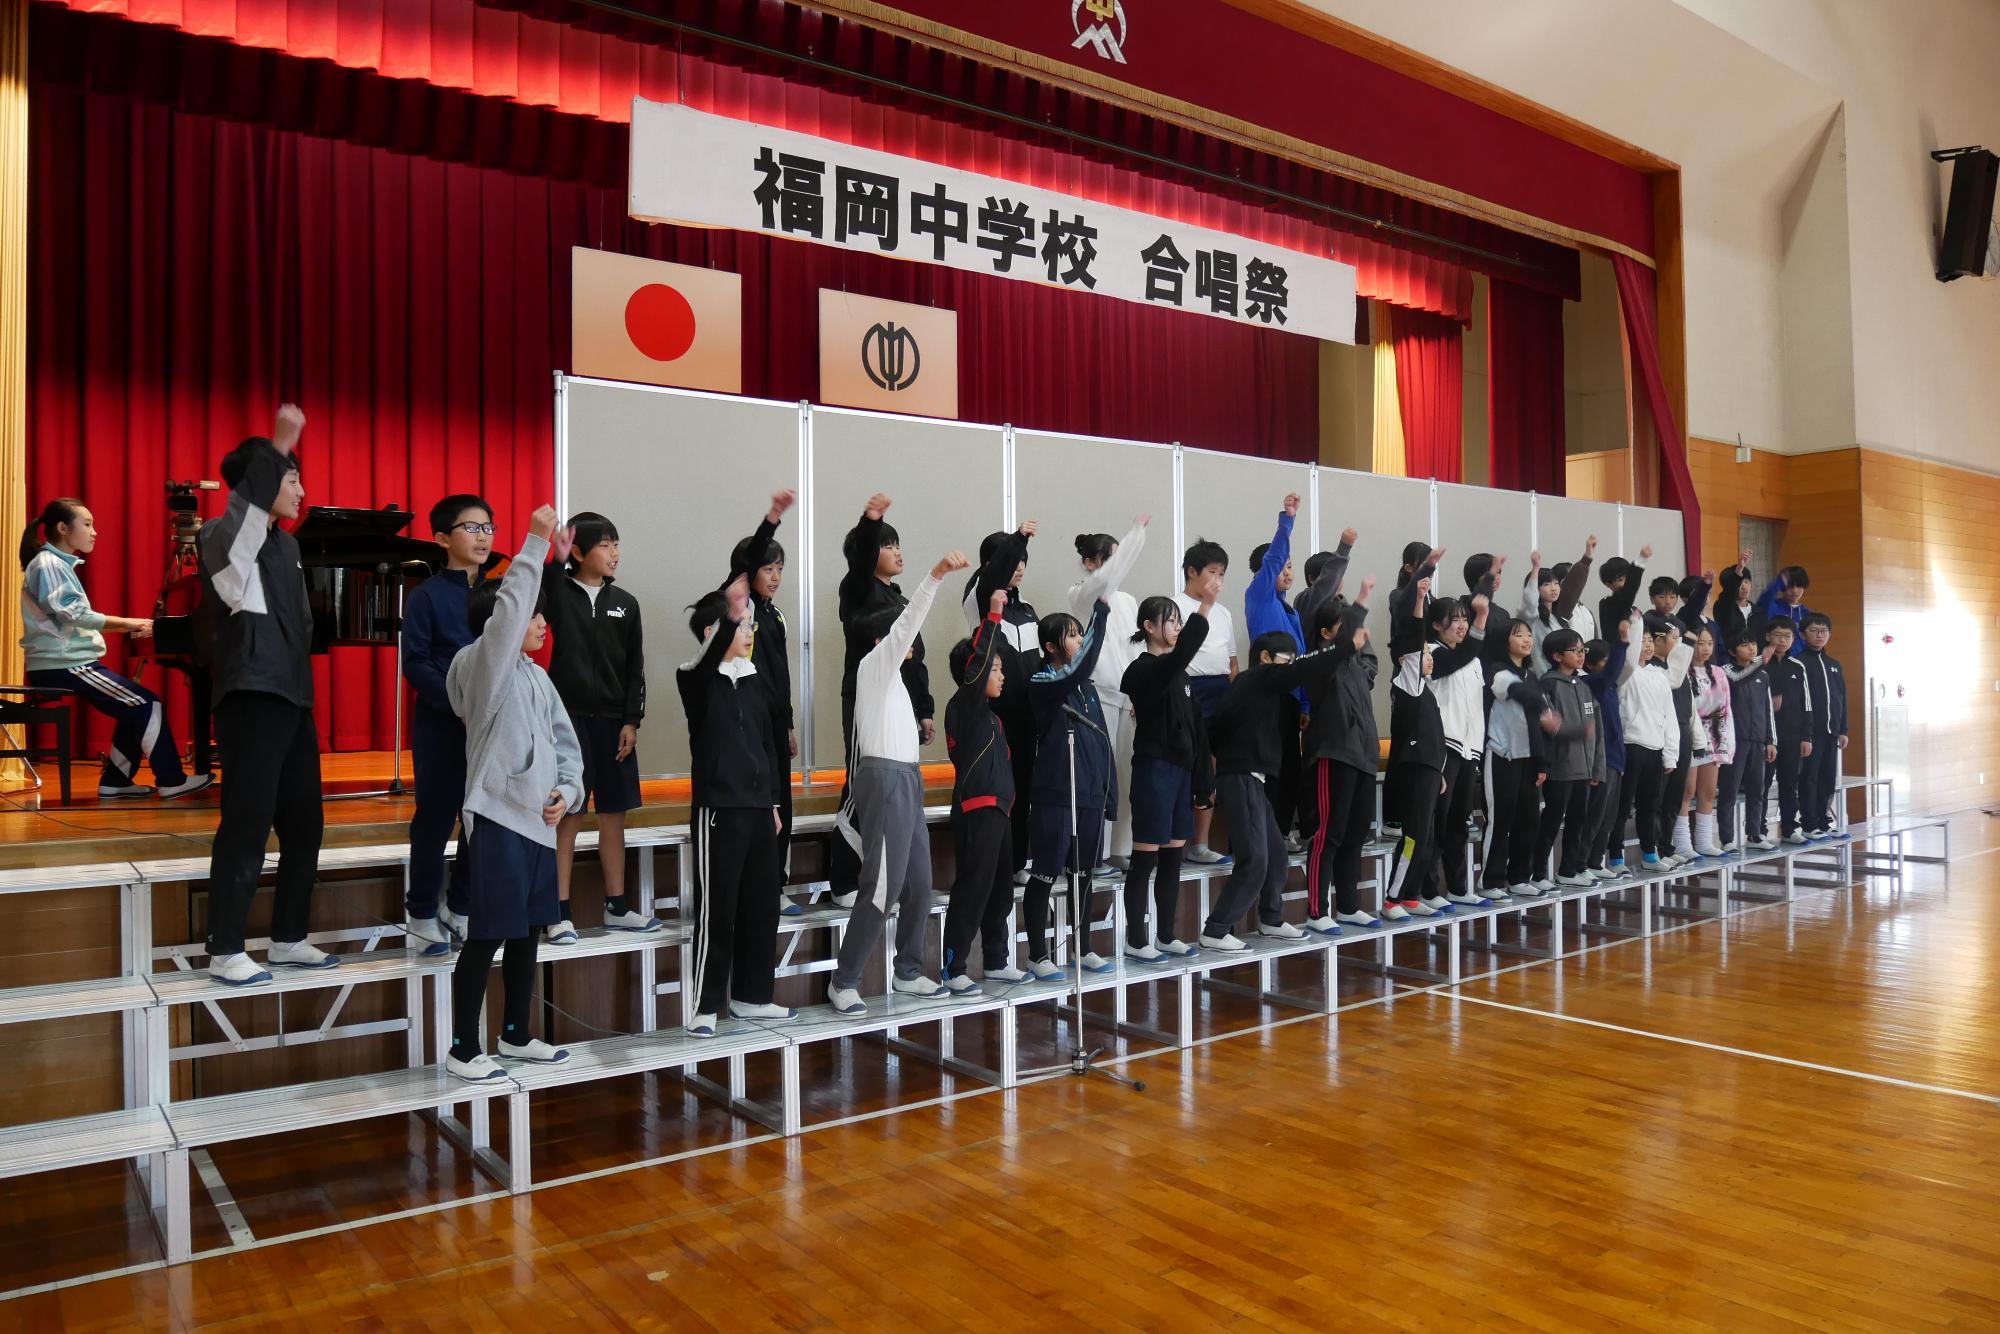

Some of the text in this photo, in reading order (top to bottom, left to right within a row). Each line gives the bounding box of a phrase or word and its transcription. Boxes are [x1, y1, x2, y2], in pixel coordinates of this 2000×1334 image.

[753, 146, 1289, 326] 福岡中学校 合唱祭
